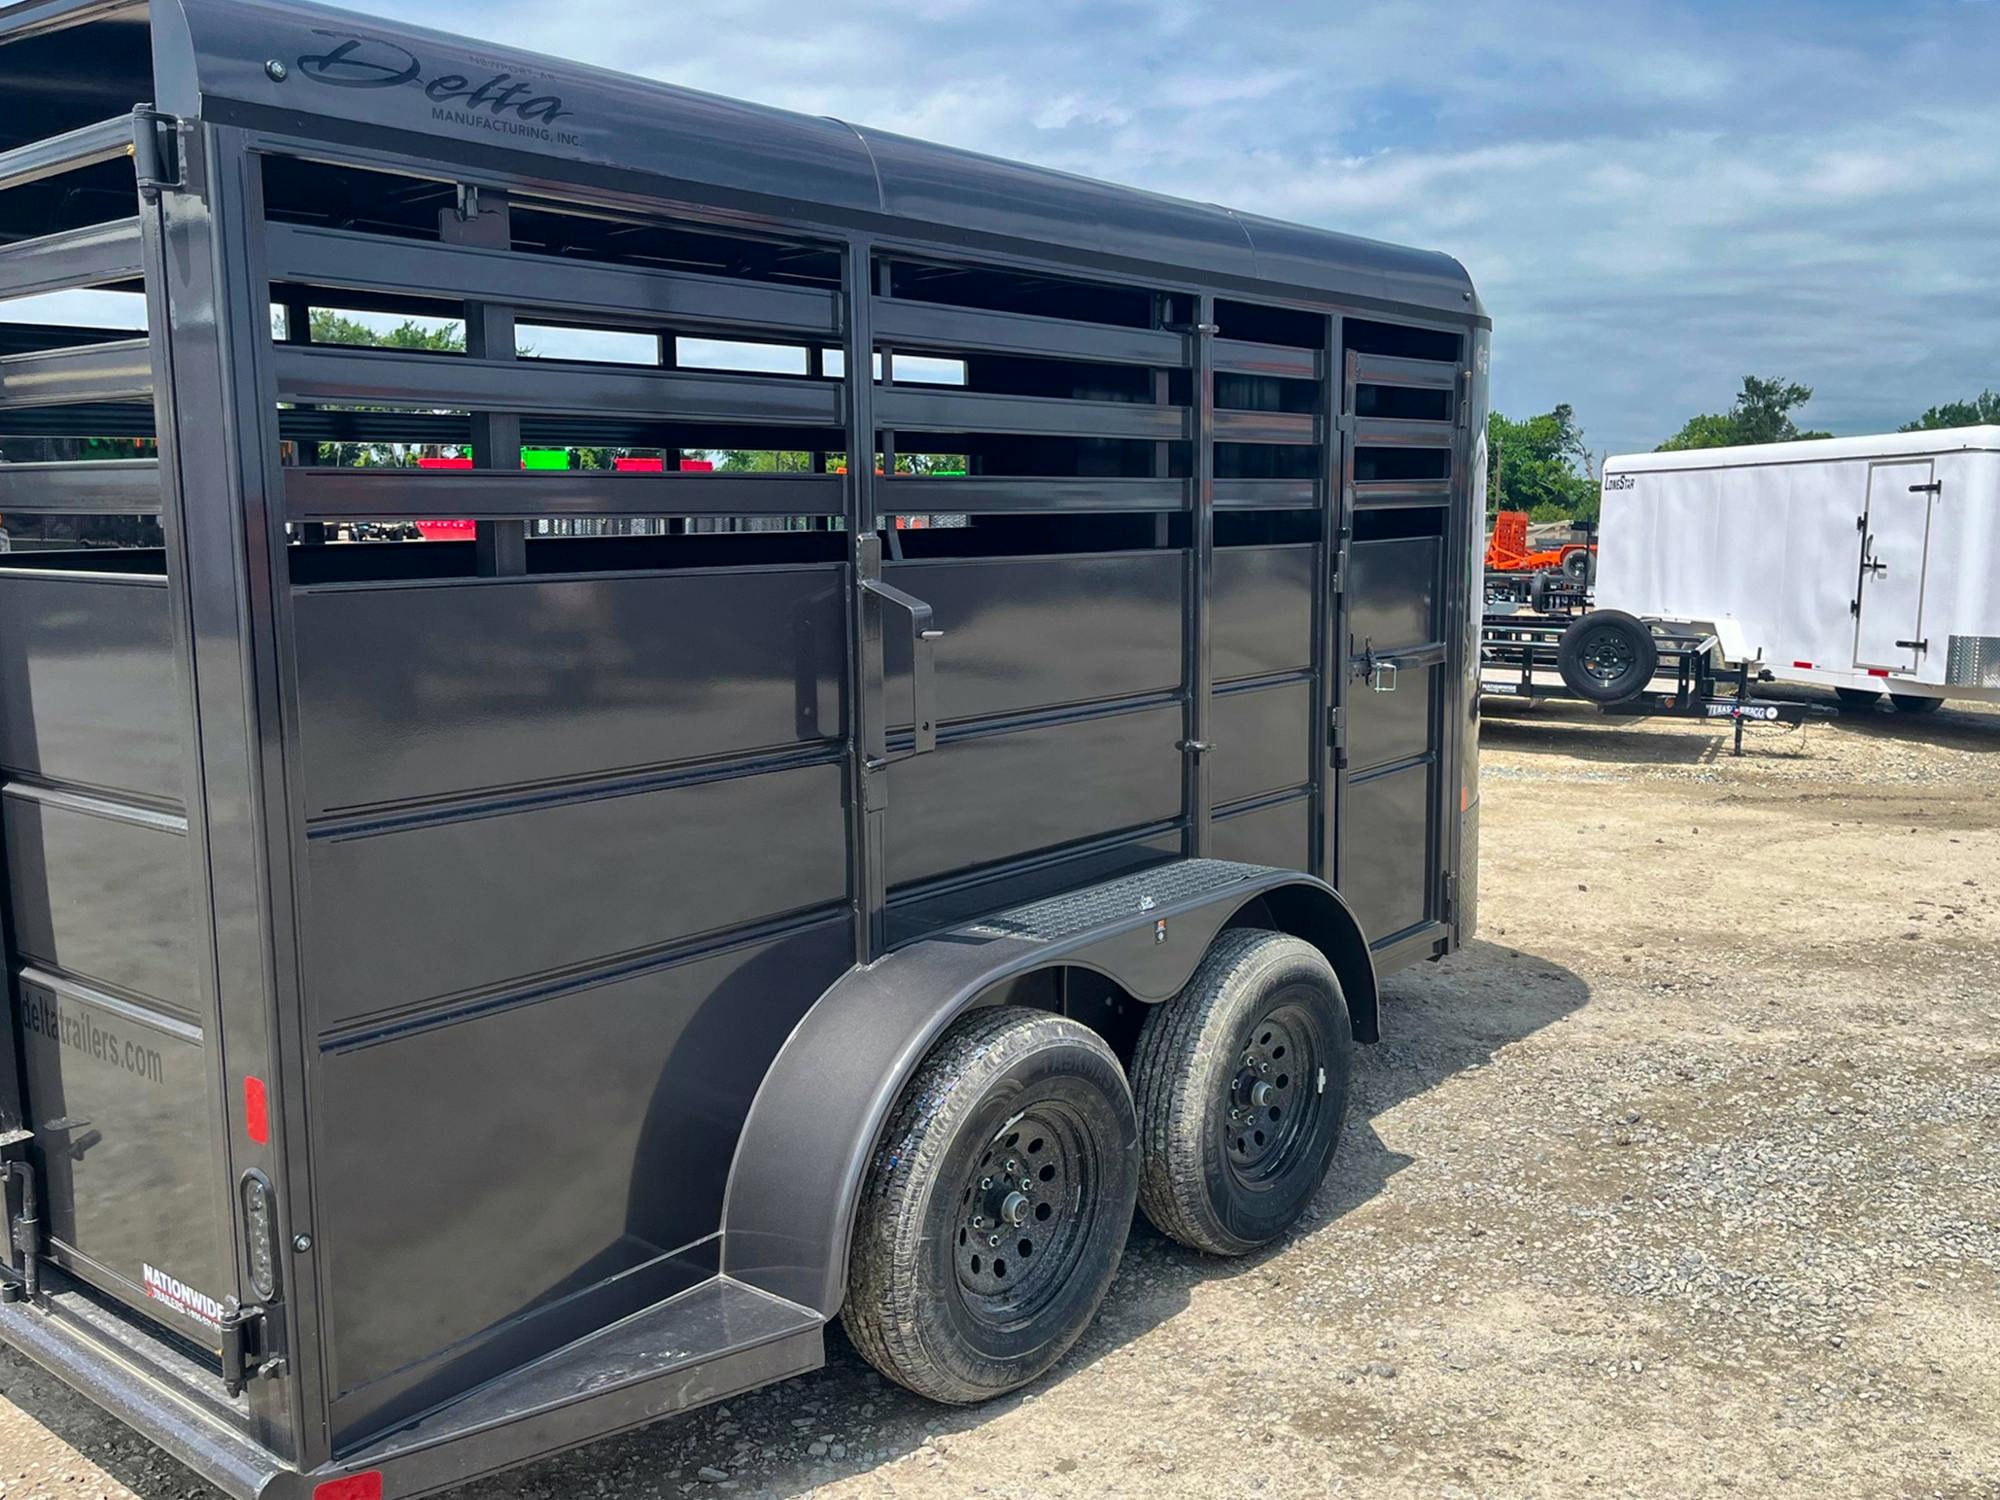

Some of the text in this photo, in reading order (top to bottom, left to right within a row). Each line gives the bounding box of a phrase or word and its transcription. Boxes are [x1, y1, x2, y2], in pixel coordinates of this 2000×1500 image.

[297, 29, 574, 125] Delta
[431, 107, 584, 147] MANUFACTURING, INC.
[22, 991, 164, 1084] deltatrailers.com
